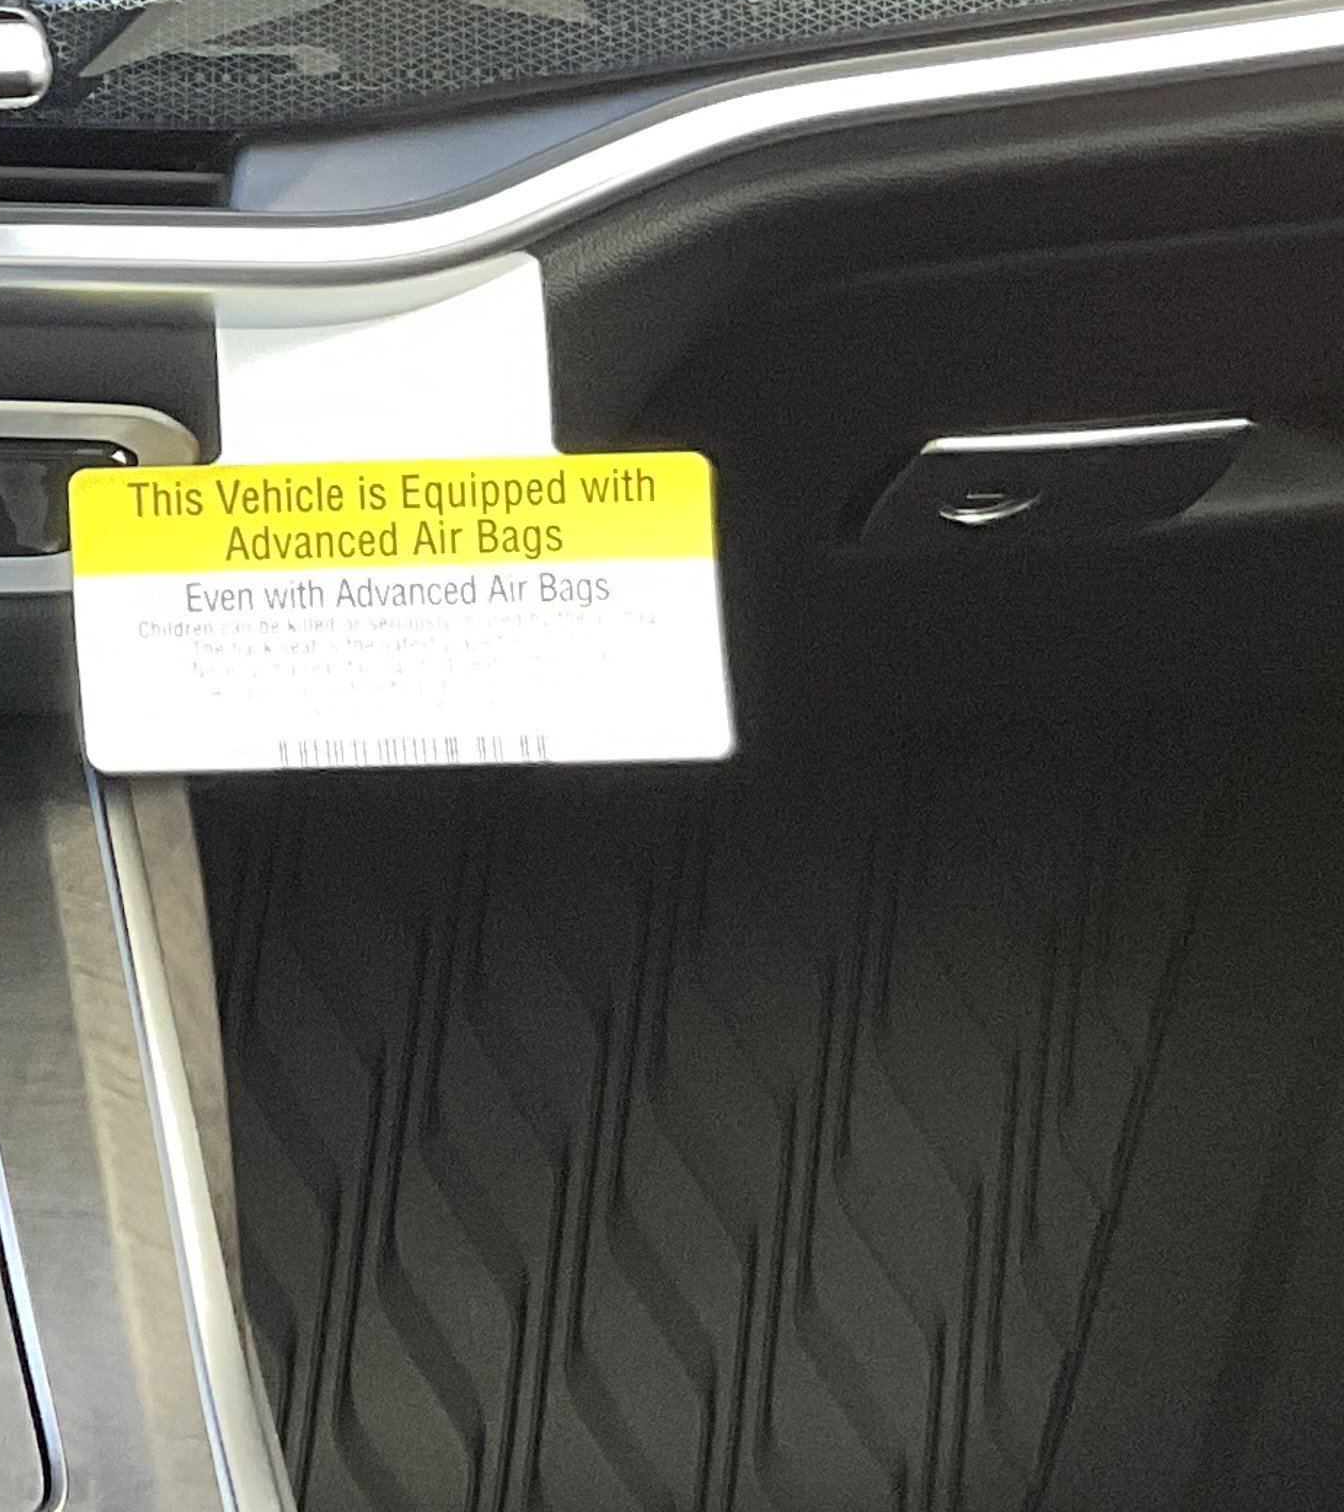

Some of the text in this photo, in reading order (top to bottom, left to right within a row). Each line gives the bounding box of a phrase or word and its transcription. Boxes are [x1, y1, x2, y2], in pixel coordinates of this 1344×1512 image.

[127, 468, 655, 517] This Vehicle is Equipped with
[226, 519, 563, 561] Advanced Air Bags
[186, 572, 610, 613] Even with Advanced Air Bags
[139, 620, 213, 639] Children
